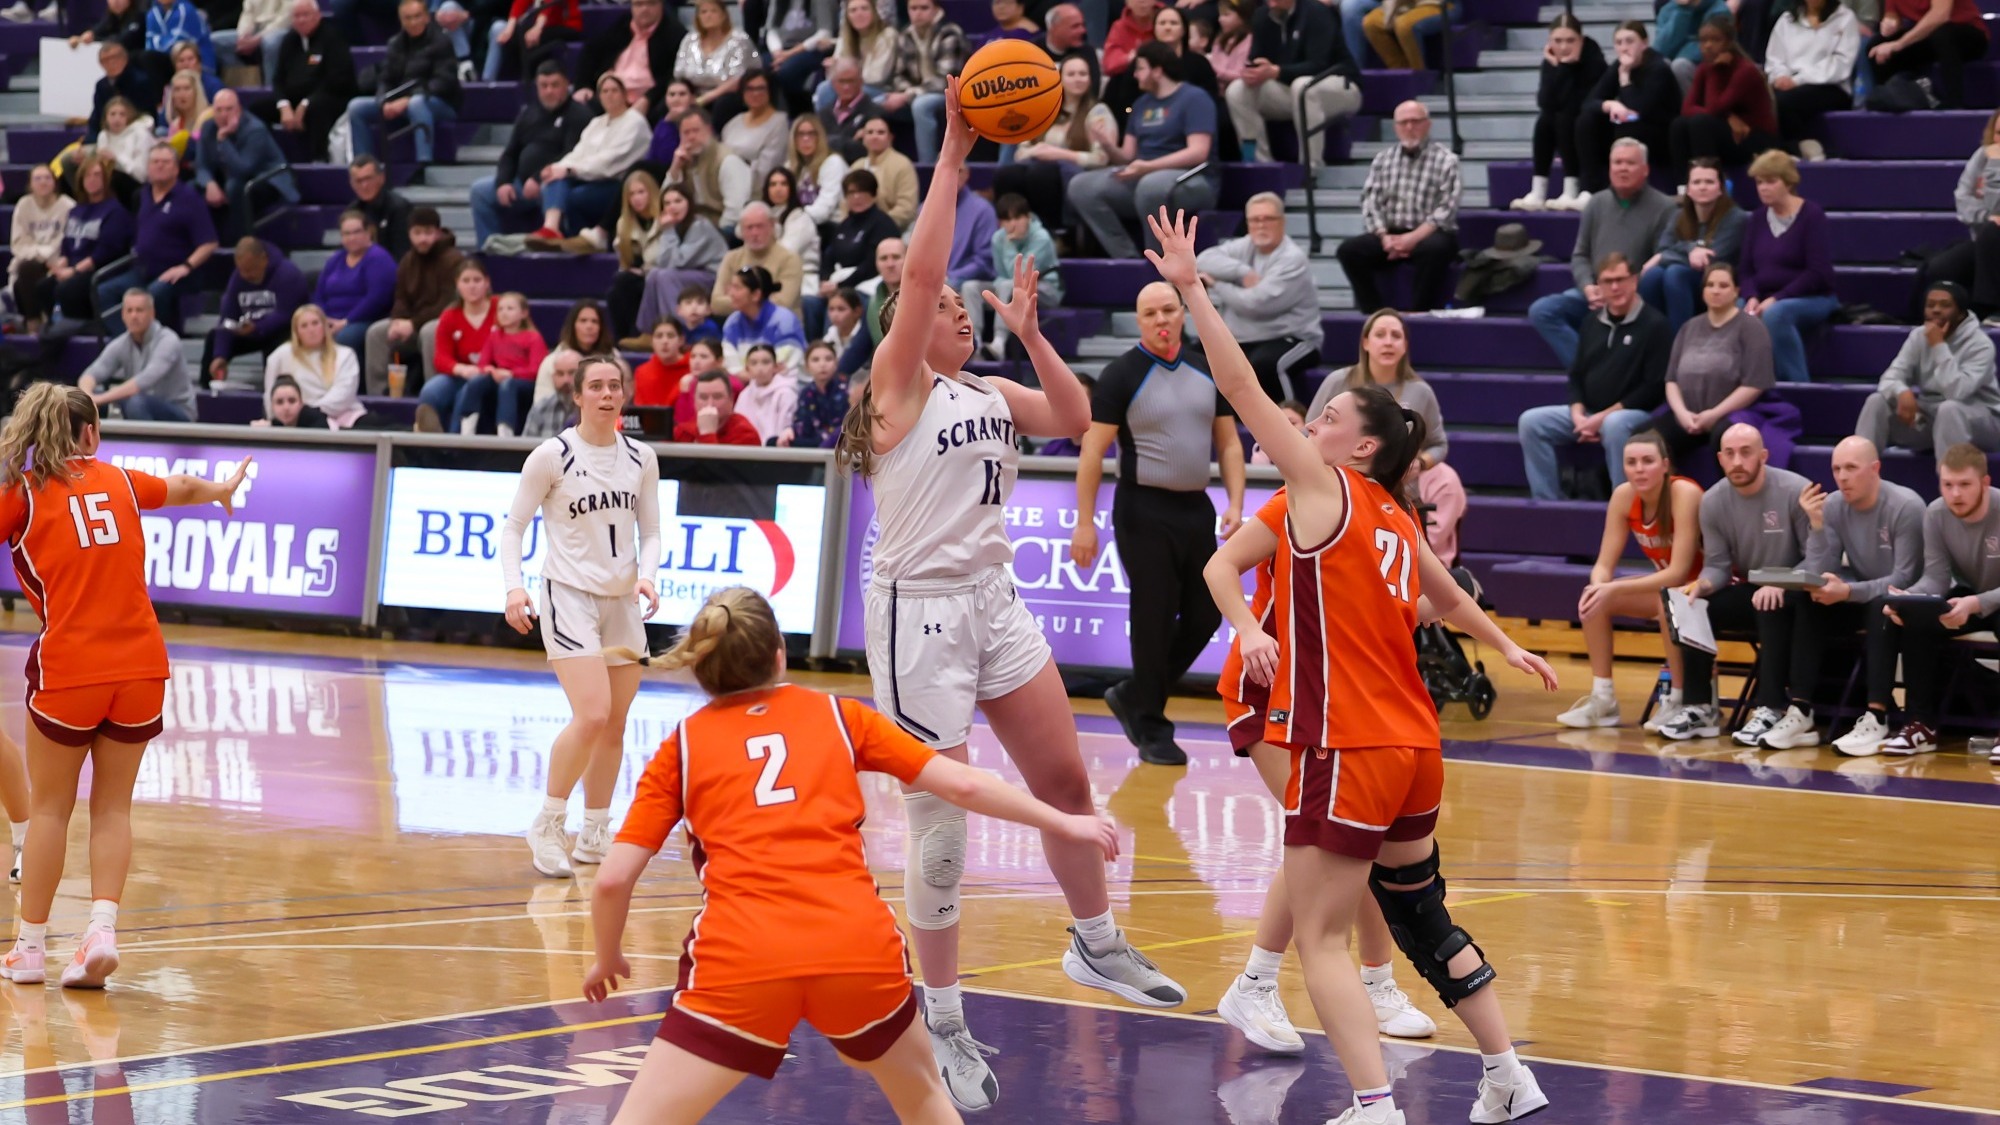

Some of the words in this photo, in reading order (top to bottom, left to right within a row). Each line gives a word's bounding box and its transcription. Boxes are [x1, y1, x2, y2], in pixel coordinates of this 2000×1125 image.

[971, 76, 1040, 100] Wilson
[569, 491, 637, 520] SCRANTO
[979, 459, 1003, 506] 11
[68, 492, 121, 549] 15
[607, 524, 618, 557] 1
[140, 515, 340, 597] ROYALS
[1374, 527, 1412, 604] 21
[744, 732, 797, 808] 2
[1467, 969, 1493, 990] DONJOY
